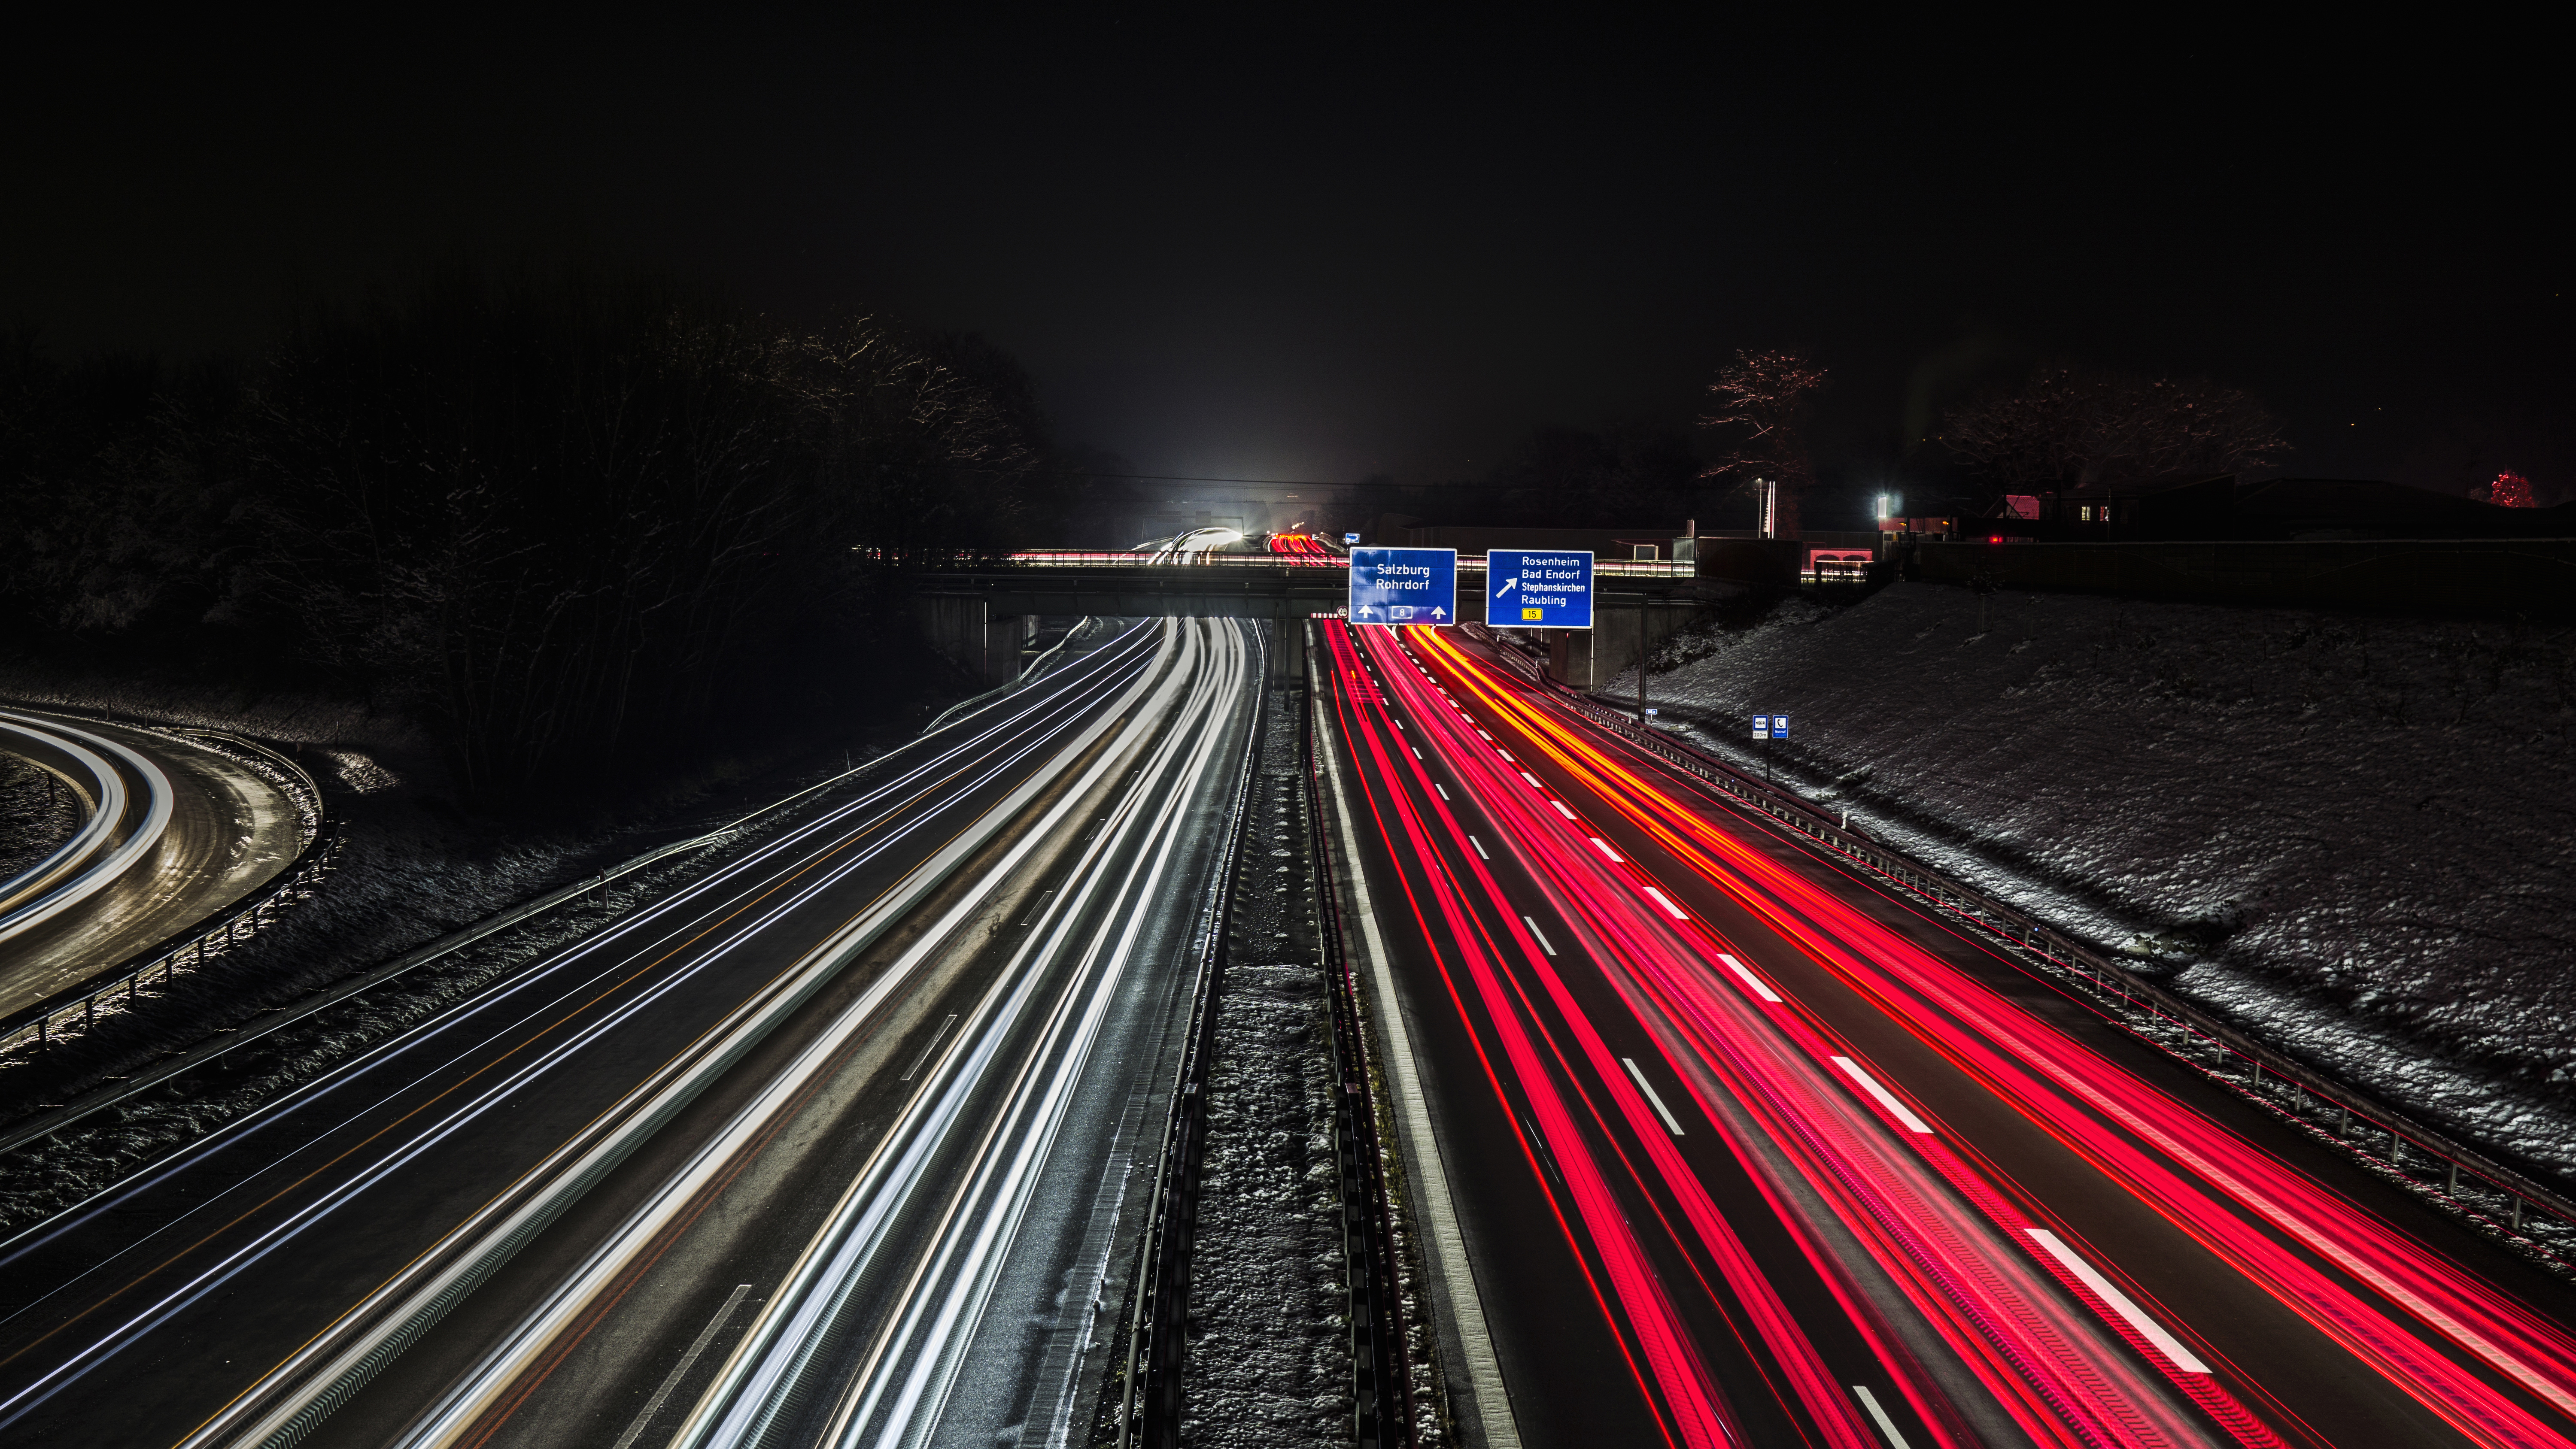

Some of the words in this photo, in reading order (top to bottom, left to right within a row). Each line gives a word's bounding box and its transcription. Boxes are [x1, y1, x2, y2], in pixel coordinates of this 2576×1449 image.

[1522, 556, 1580, 566] Rosenheim
[1377, 564, 1430, 578] Salzburg
[1522, 569, 1541, 579] Bad
[1546, 570, 1580, 579] Endorf
[1376, 579, 1430, 590] Rohrdorf
[1522, 582, 1585, 594] Stephanskirchen
[1522, 595, 1566, 607] Raubling
